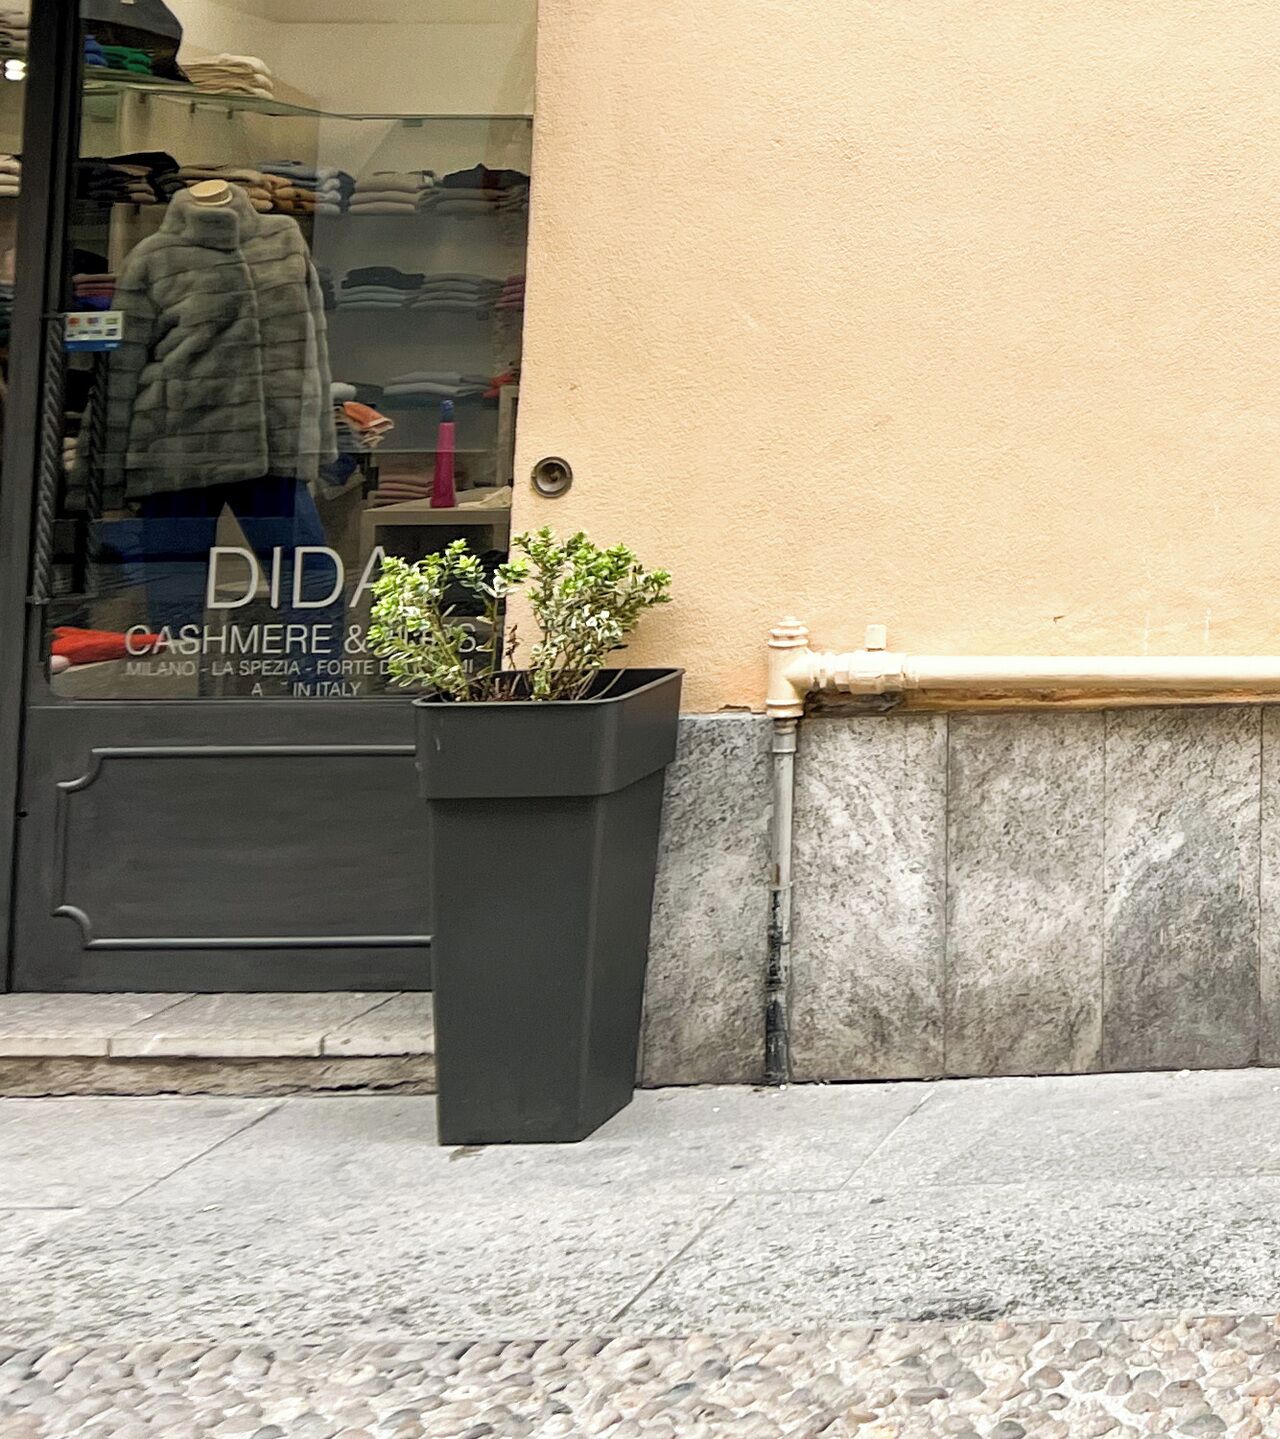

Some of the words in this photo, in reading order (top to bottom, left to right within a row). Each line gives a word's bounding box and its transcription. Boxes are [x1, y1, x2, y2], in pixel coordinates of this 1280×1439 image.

[125, 624, 333, 655] CASHMERE
[344, 624, 368, 654] &
[125, 661, 196, 676] MILANO
[212, 661, 234, 676] LA
[239, 661, 301, 676] SPEZIA
[317, 660, 374, 675] FORTE
[293, 682, 311, 697] IN
[316, 681, 362, 697] ITALY
